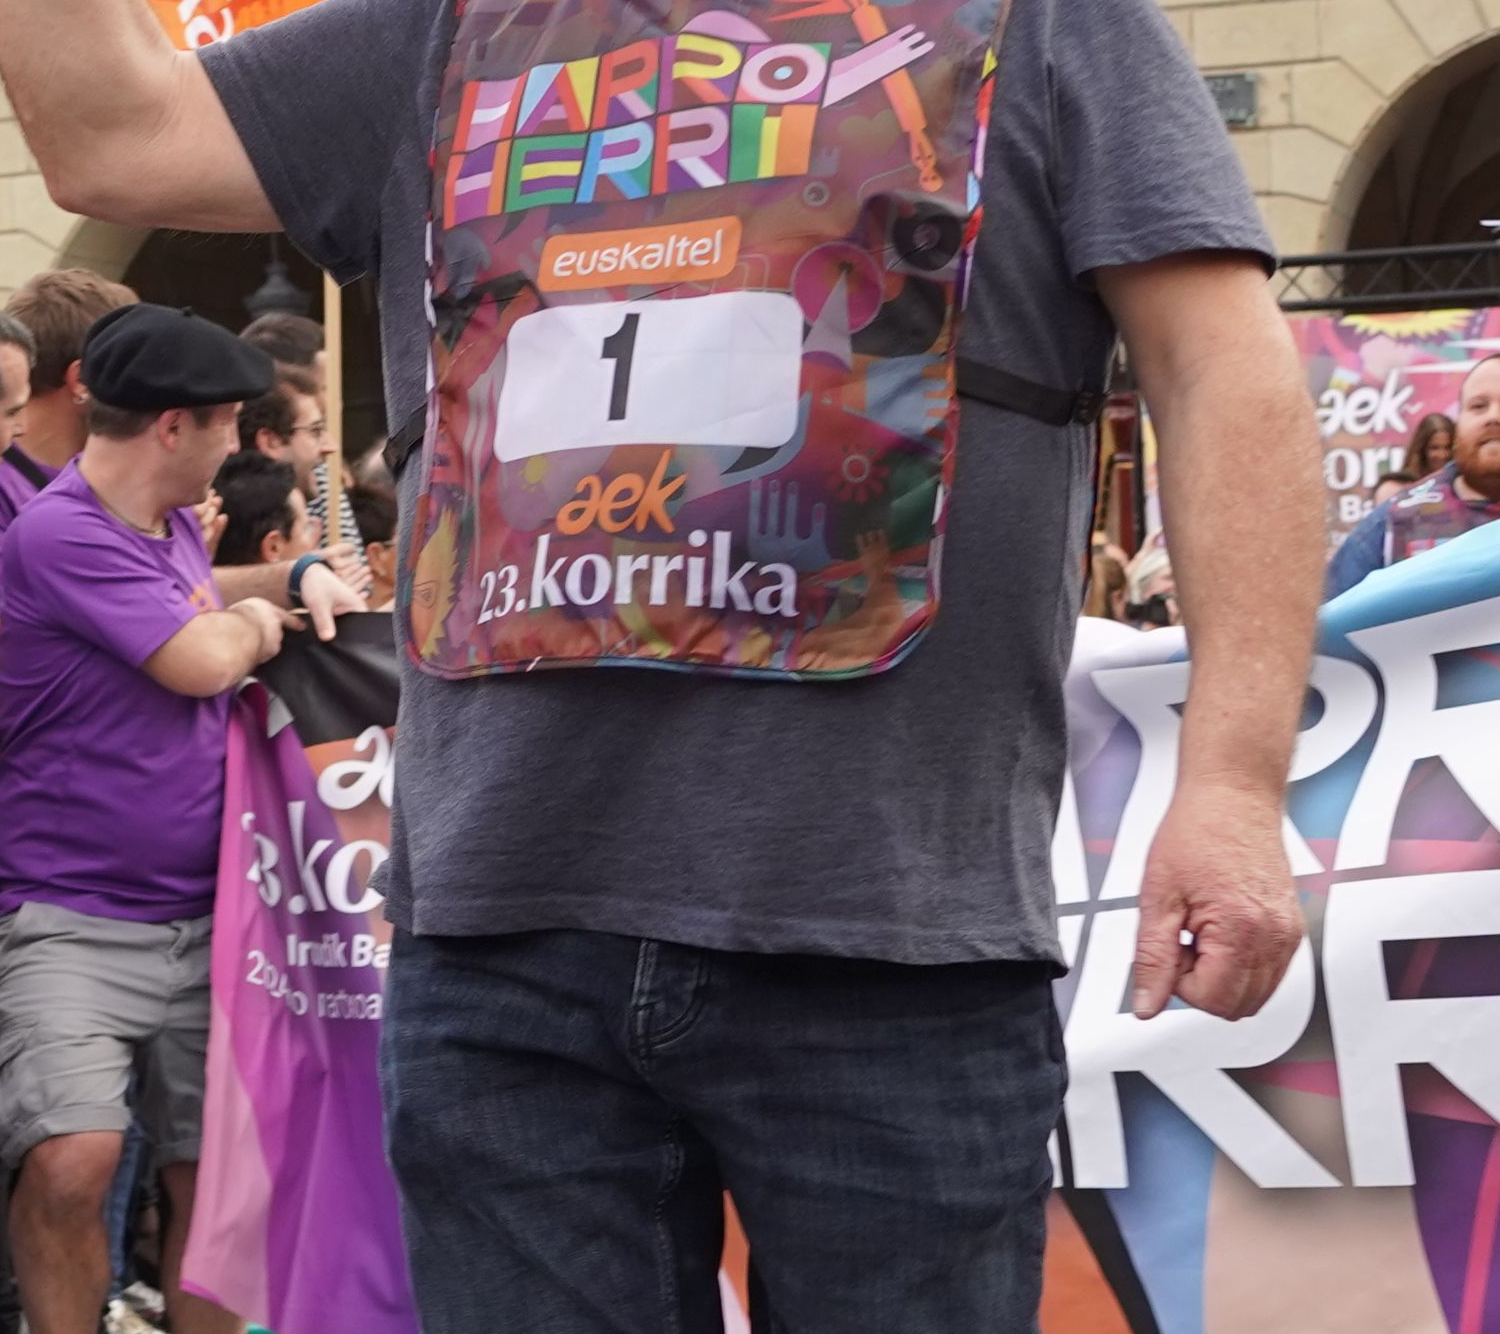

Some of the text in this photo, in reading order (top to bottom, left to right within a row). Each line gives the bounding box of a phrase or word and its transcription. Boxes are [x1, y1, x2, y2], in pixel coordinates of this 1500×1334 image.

[452, 33, 833, 154] HARRO
[552, 228, 724, 278] euskaltel
[600, 312, 641, 422] 1
[556, 448, 688, 535] aek
[475, 528, 802, 625] 23.korrika
